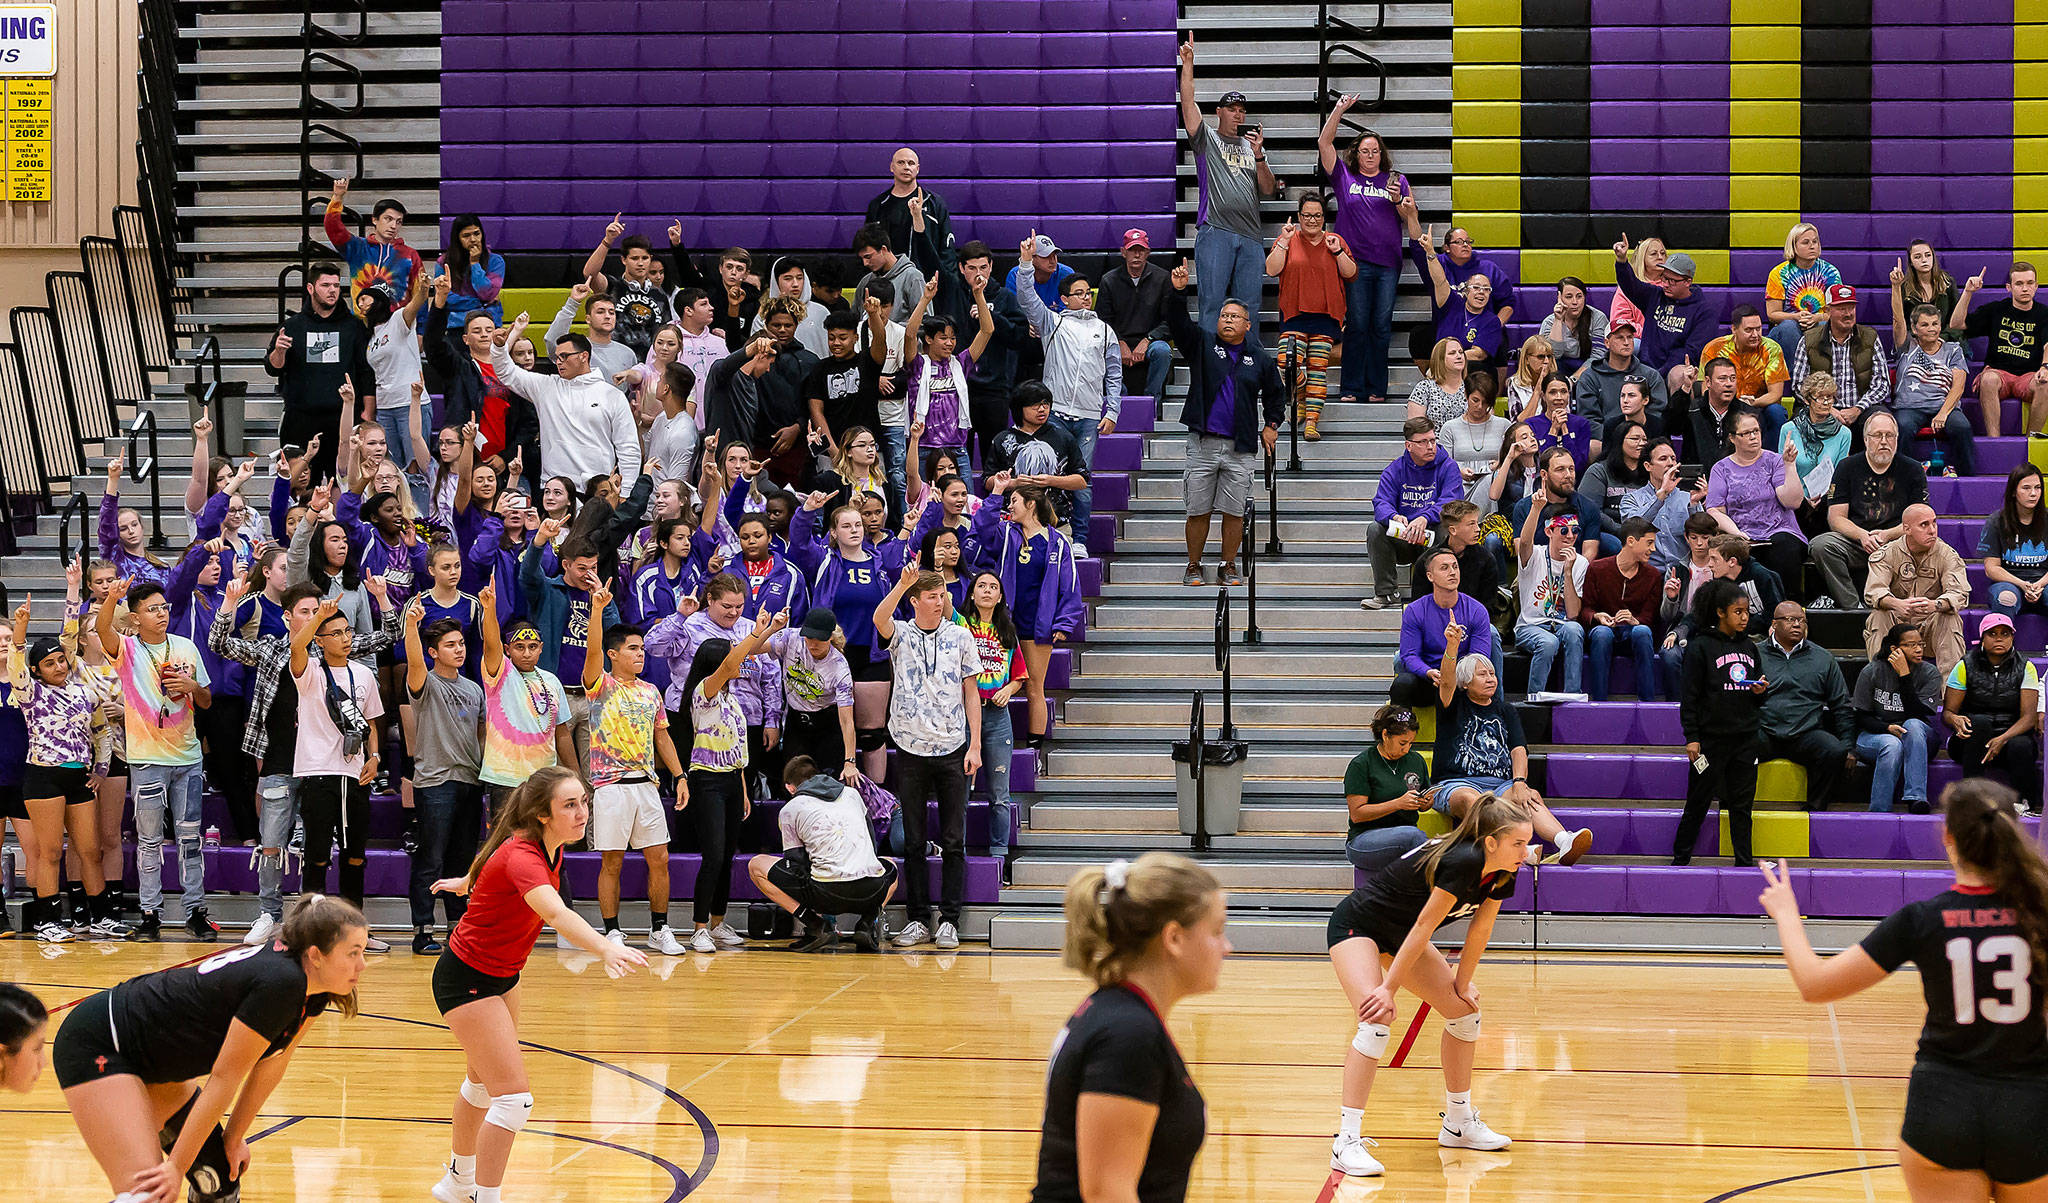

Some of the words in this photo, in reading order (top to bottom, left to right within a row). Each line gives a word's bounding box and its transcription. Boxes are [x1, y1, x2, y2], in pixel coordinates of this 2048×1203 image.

[17, 98, 42, 108] 1997
[15, 129, 44, 138] 2002
[16, 159, 44, 168] 2006
[15, 190, 43, 199] 2012
[615, 293, 662, 324] HOLLISTER
[2001, 316, 2025, 331] CLASS
[2025, 322, 2036, 332] OF
[1997, 345, 2031, 359] SENIORS
[1018, 545, 1034, 564] 5
[847, 568, 872, 585] 15
[981, 658, 1006, 672] HARBO
[340, 697, 369, 732] NIKE
[1944, 934, 2032, 1024] 13
